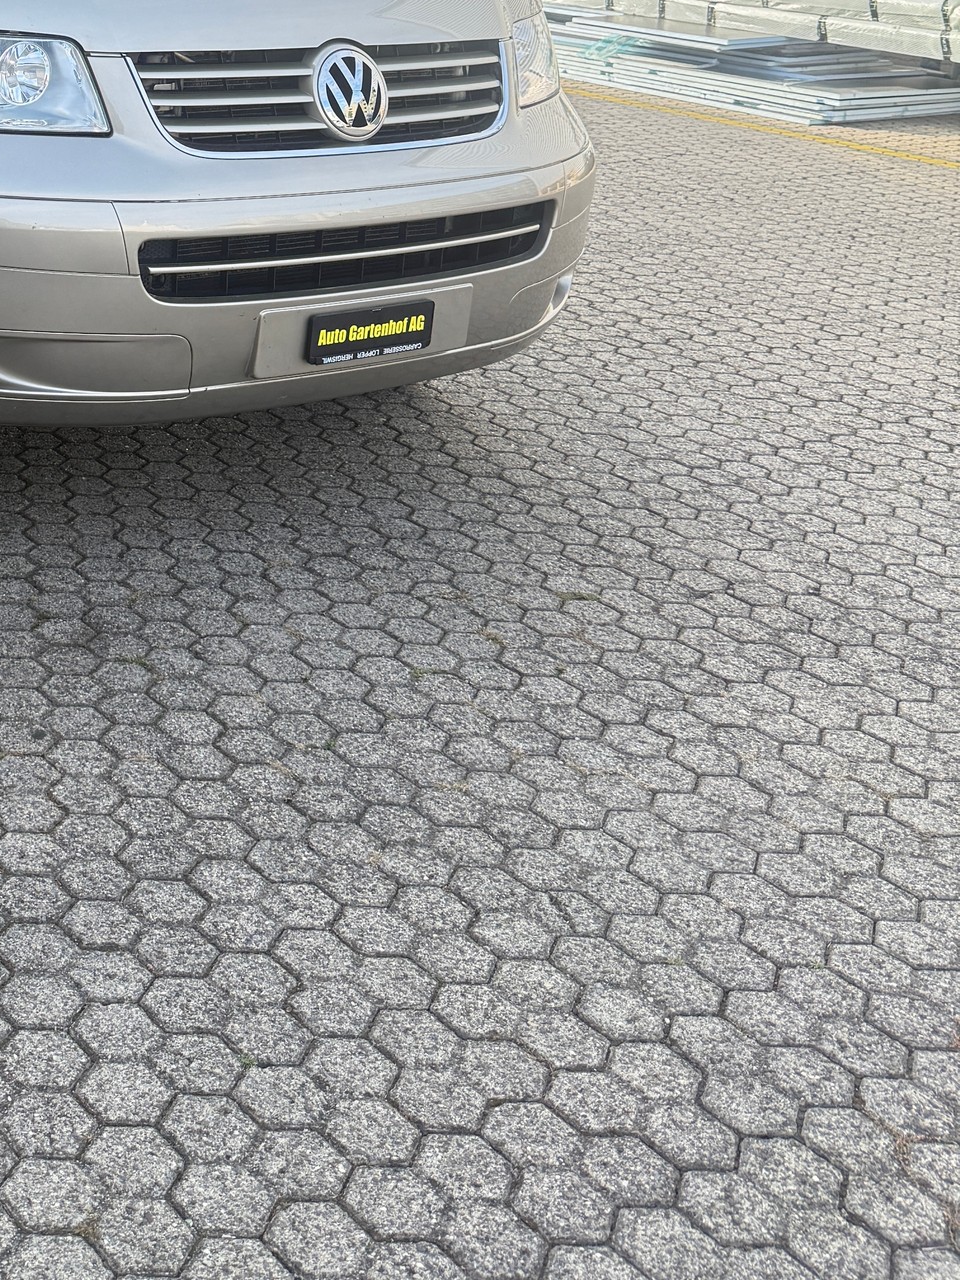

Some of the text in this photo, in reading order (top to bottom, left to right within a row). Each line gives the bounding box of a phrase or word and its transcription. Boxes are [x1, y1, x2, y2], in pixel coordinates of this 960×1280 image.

[318, 315, 426, 346] Auto Gartenhof AG
[322, 342, 422, 364] CARROSSERIE LOPPER HERGISWIL
